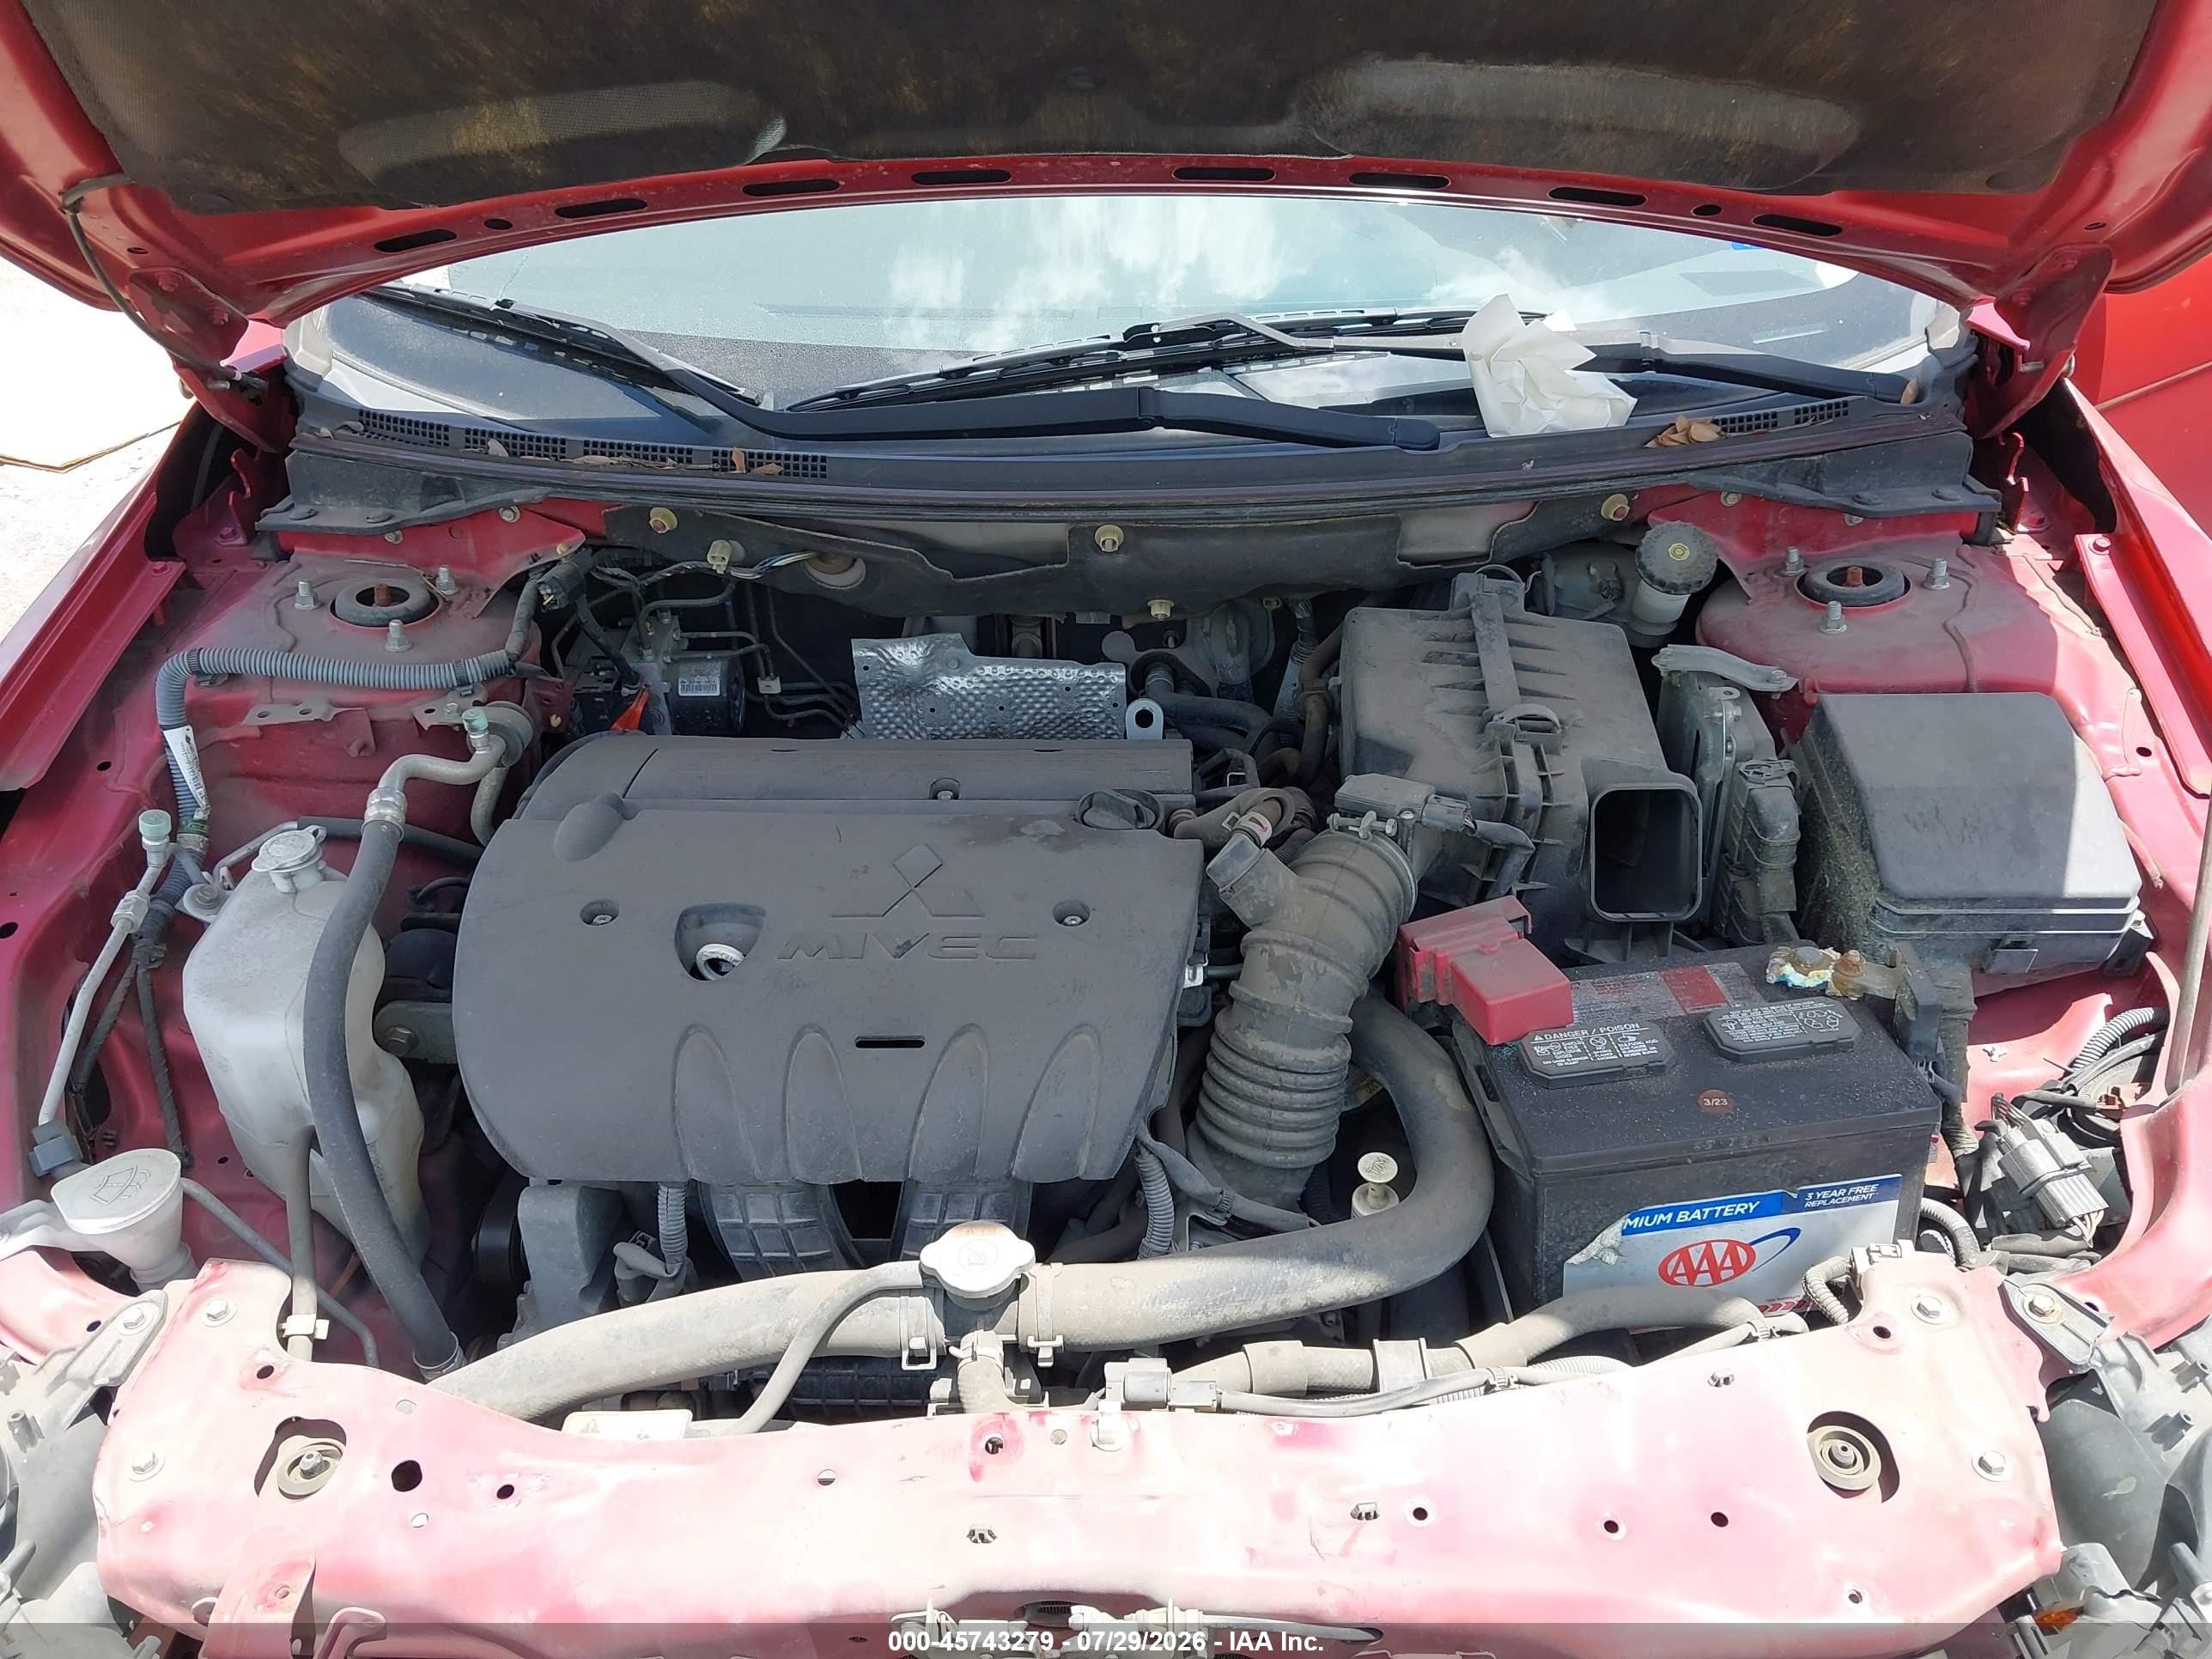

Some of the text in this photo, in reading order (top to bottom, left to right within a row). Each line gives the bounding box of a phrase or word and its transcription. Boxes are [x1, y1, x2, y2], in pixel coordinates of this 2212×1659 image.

[776, 933, 1036, 960] MIVEC
[1545, 1030, 1589, 1041] DANGER
[1599, 1023, 1640, 1033] POISON
[1703, 1098, 1729, 1107] 3/23
[1805, 1184, 1880, 1201] 3 YEAR FREE
[1675, 1200, 1761, 1224] BATTERY
[1667, 1241, 1750, 1286] AAA
